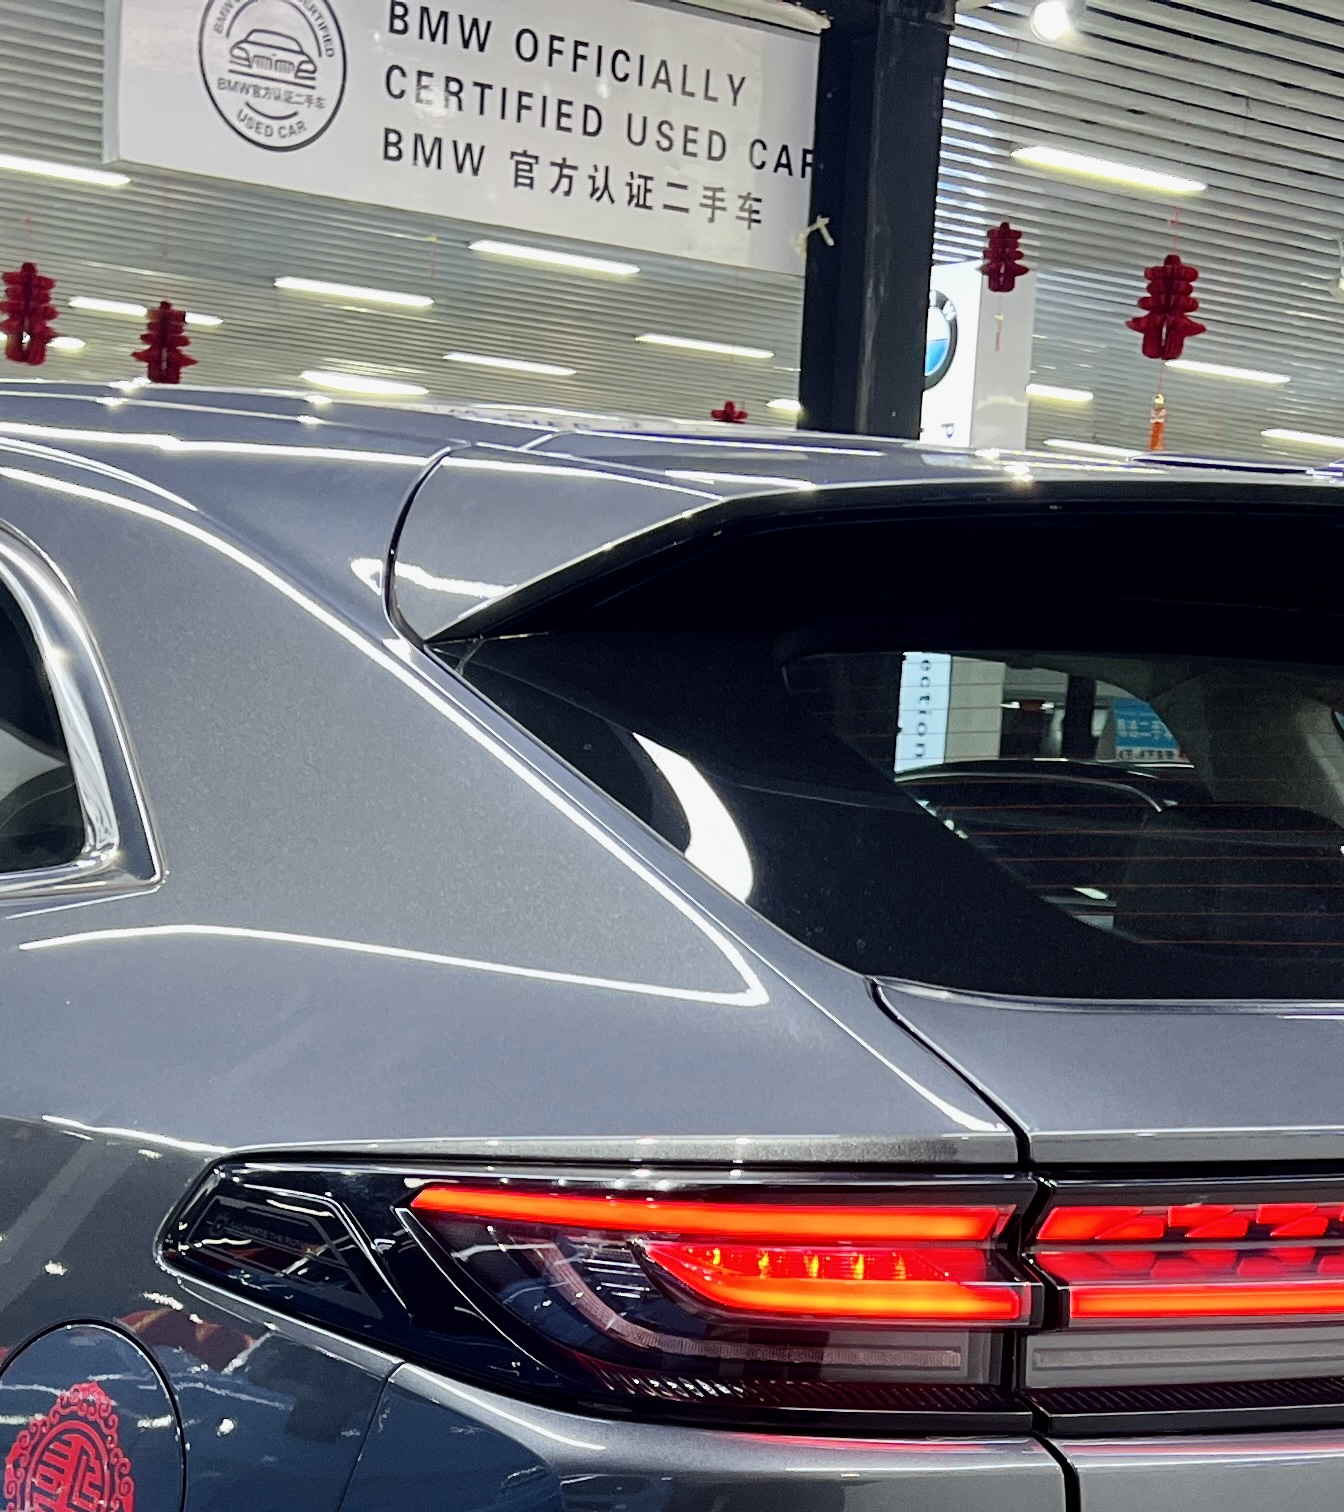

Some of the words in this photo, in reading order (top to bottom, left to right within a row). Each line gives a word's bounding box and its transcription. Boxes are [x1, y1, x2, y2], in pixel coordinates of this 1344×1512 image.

[388, 0, 492, 54] BMW
[514, 28, 747, 107] OFFICIALLY
[236, 108, 274, 138] USED
[277, 120, 307, 139] CAR
[385, 65, 603, 138] CERTIFIED
[626, 113, 727, 162] USED
[383, 128, 485, 177] BMW
[510, 149, 763, 230] 官方认证二手车
